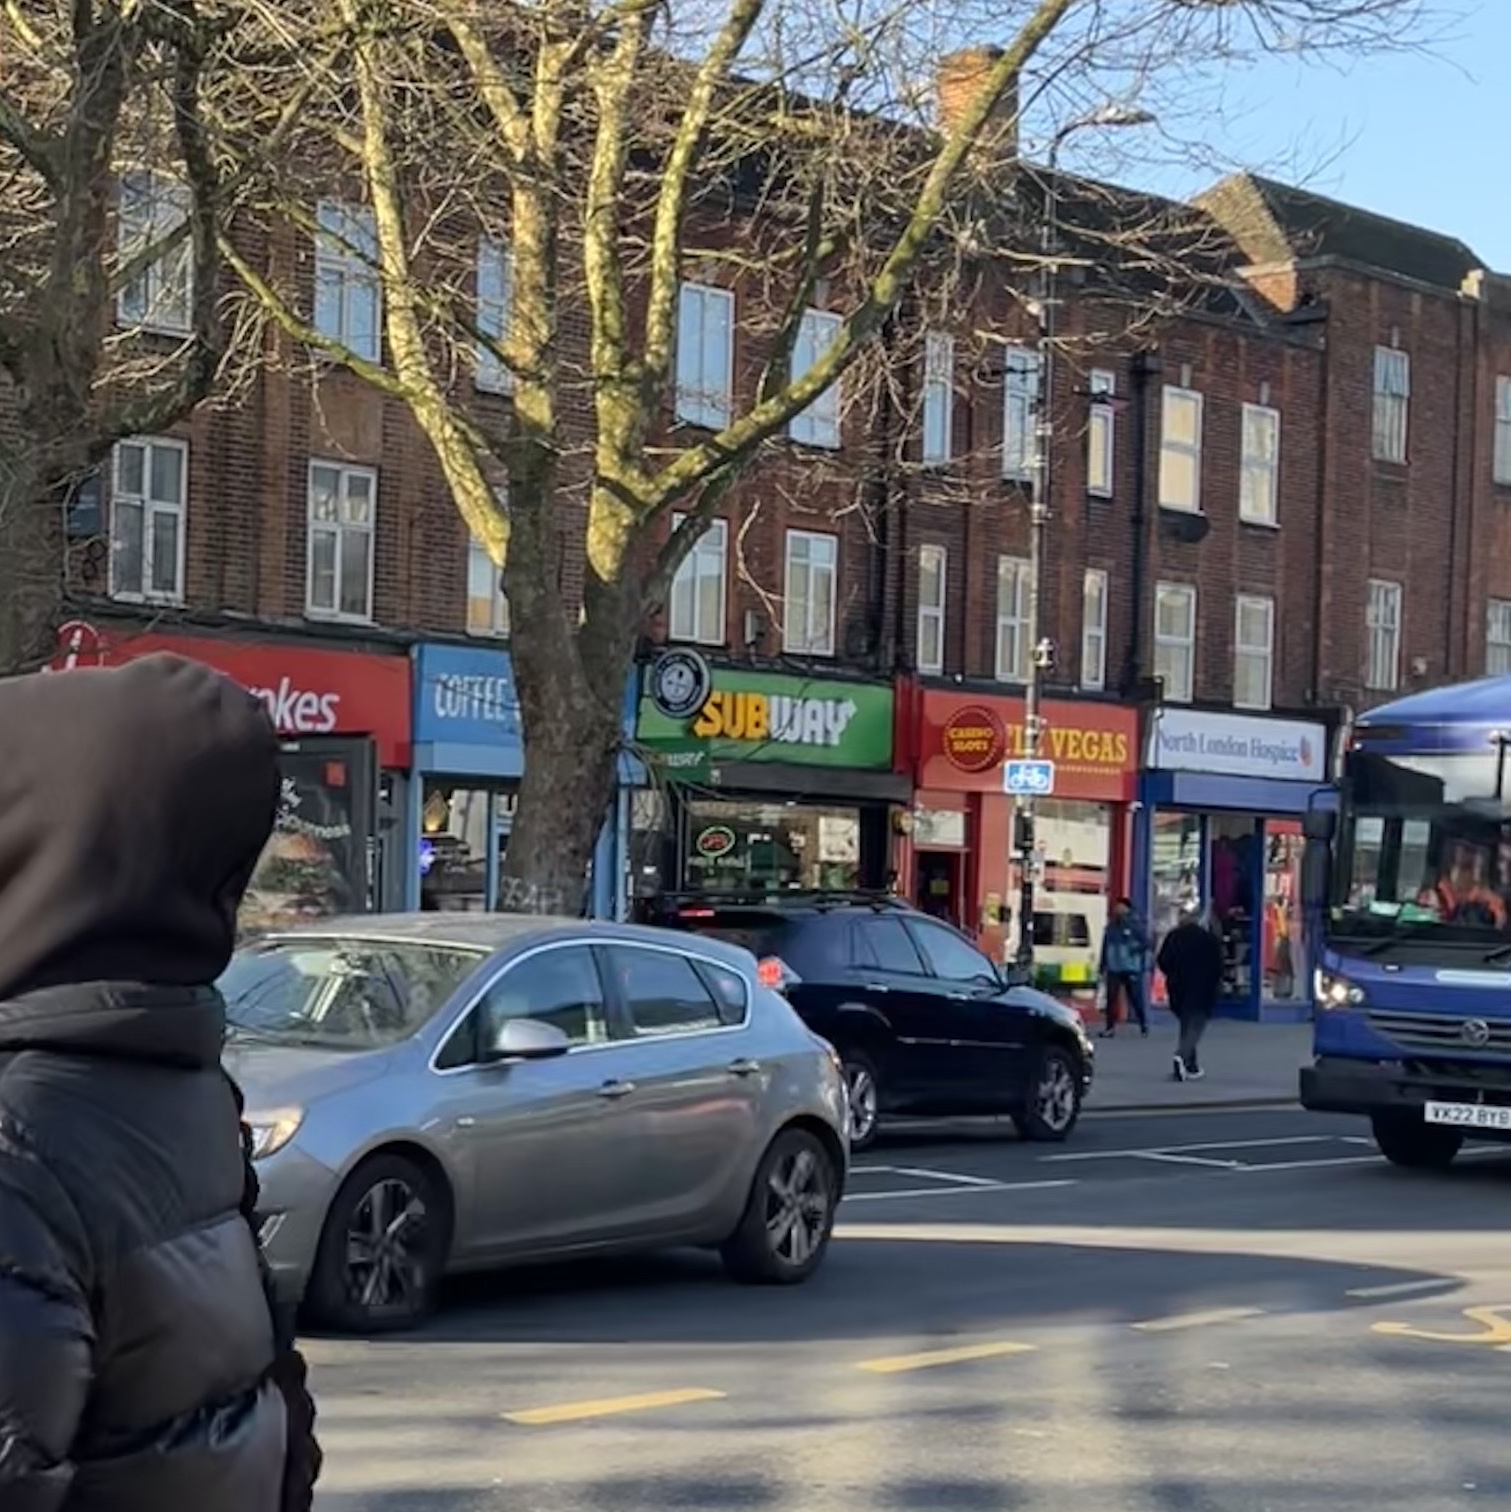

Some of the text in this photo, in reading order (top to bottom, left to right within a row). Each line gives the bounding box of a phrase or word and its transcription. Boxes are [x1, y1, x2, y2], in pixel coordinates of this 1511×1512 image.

[434, 673, 508, 721] COFFEE
[693, 690, 857, 746] SUBWAY
[1050, 726, 1128, 763] VEGAS
[1200, 733, 1248, 757] London
[1250, 737, 1298, 764] Hospice
